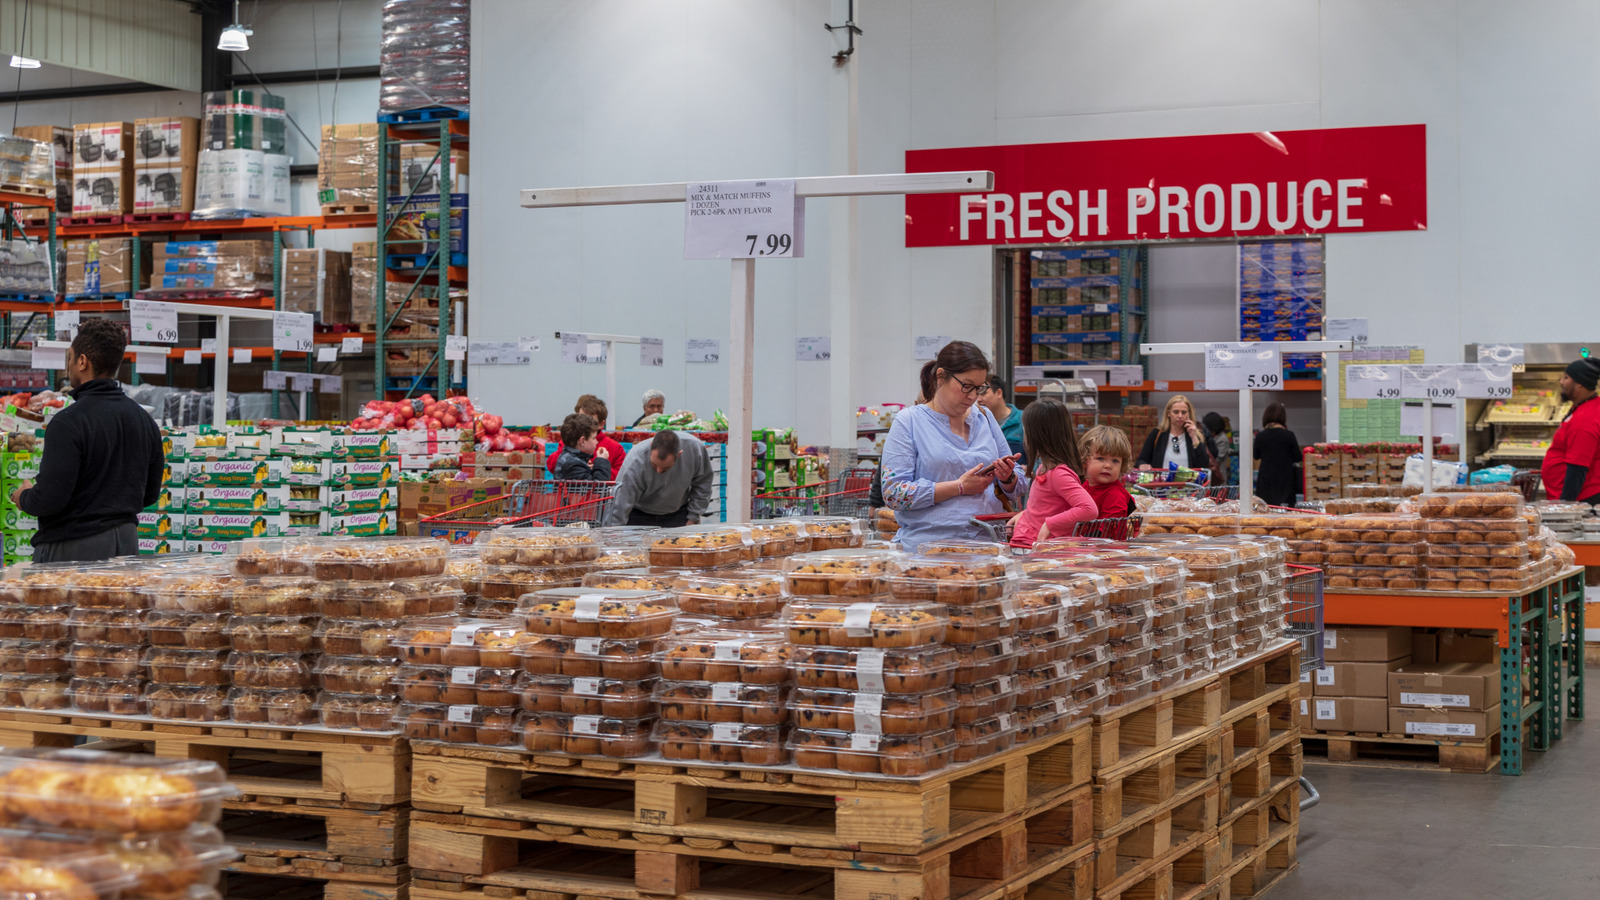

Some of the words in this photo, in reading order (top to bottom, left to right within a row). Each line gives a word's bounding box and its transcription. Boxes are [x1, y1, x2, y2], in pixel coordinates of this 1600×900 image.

[699, 184, 718, 193] 24311
[740, 191, 771, 200] MUFFINS
[708, 208, 726, 216] 2-6PK
[727, 207, 742, 215] ANY
[744, 206, 772, 214] FLAVOR
[959, 188, 1108, 241] FRESH
[1127, 177, 1365, 236] PRODUCE
[745, 233, 792, 256] 7.99
[157, 329, 177, 341] 6.99
[296, 340, 313, 351] 1.99
[704, 354, 719, 362] 5.79
[815, 352, 831, 360] 6.99
[1247, 373, 1279, 388] 5.99
[1376, 388, 1400, 398] 4.99
[1427, 387, 1456, 398] 10.99
[1487, 386, 1511, 397] 9.99
[350, 435, 379, 446] Organic
[213, 462, 252, 473] Organic
[353, 462, 381, 474] Organic
[212, 488, 251, 500] Organic
[351, 489, 379, 501] Organic
[136, 513, 157, 522] anic
[211, 515, 250, 527] Organic
[350, 514, 378, 526] Organic
